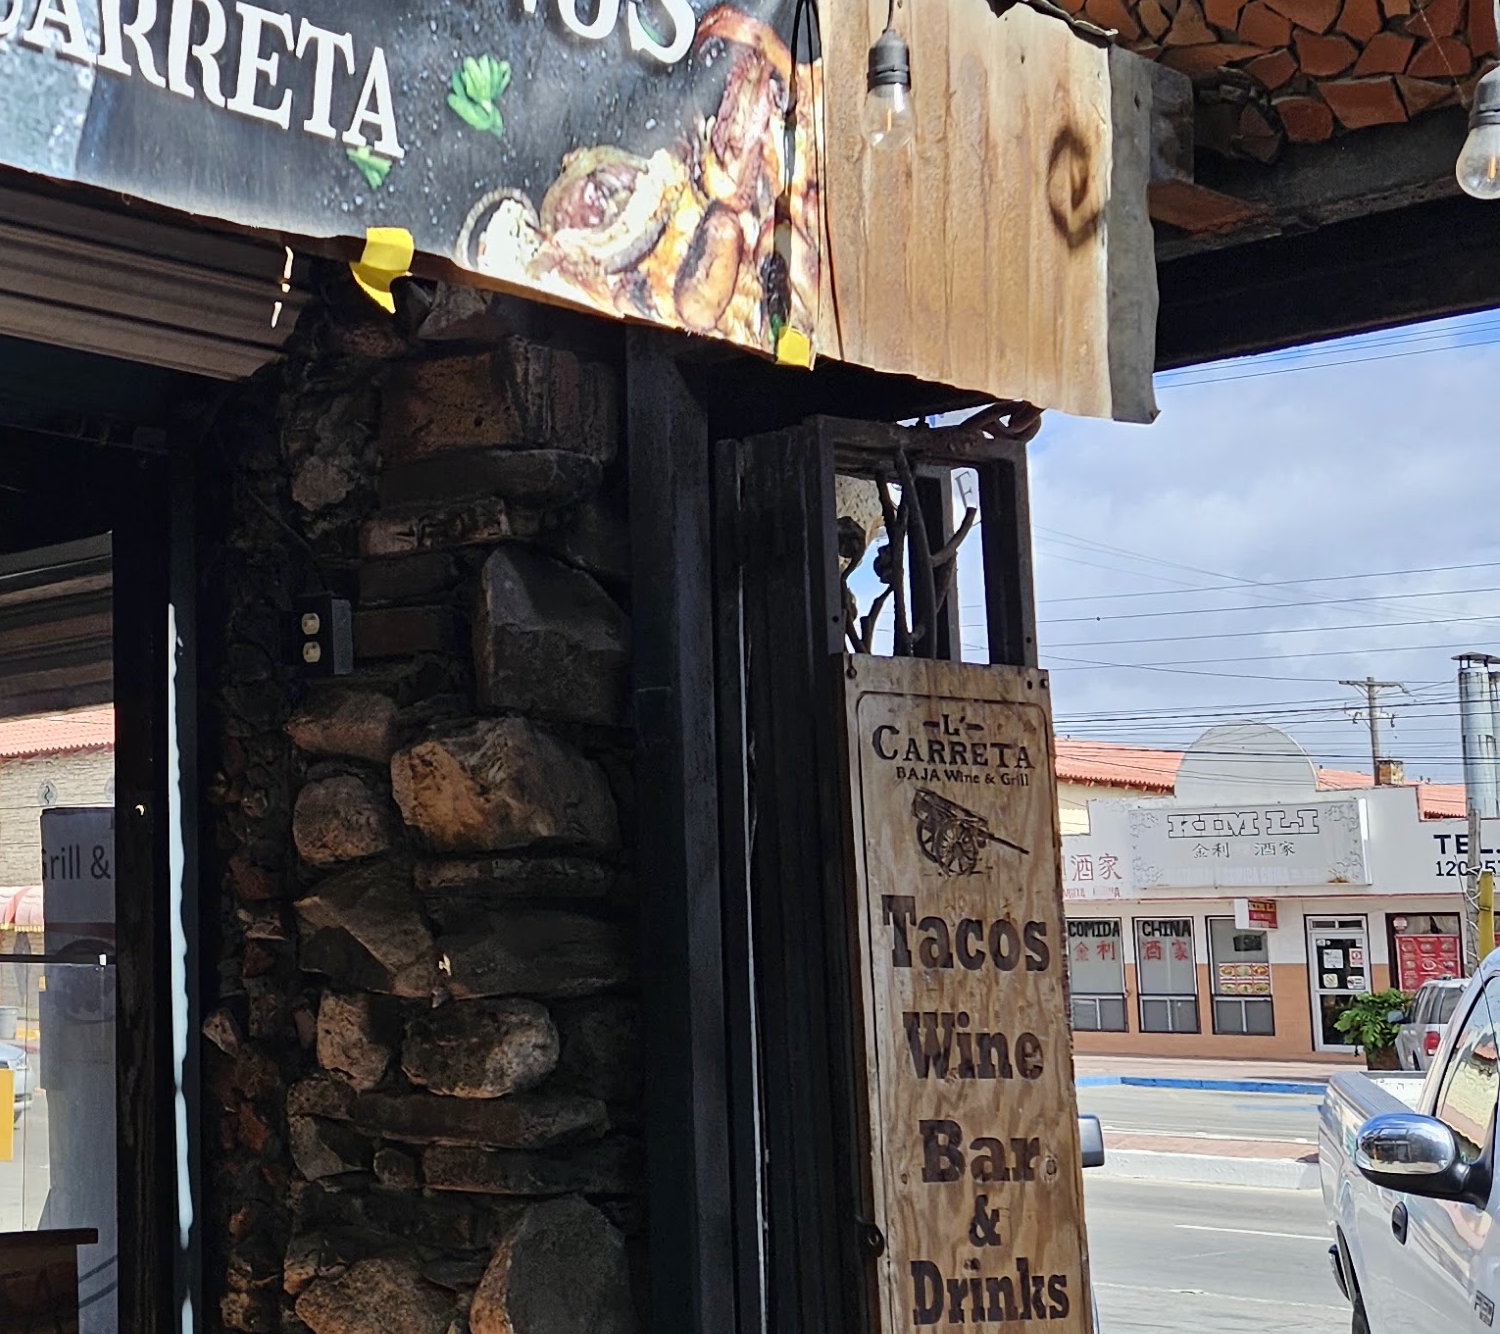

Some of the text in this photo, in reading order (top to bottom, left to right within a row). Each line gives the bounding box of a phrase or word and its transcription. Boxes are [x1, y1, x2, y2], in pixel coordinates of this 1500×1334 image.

[871, 724, 1037, 769] CARRETA
[896, 767, 1029, 786] BAJA Wine & Grill
[1167, 809, 1320, 838] KIM LI
[91, 844, 111, 880] &
[1063, 853, 1122, 881] 酒家
[1192, 841, 1296, 858] 金利 酒家
[881, 894, 1050, 972] Tacos
[1068, 920, 1191, 937] COMIDA CHINA
[1074, 939, 1190, 962] 金利 酒家
[902, 1011, 1045, 1081] Wine
[918, 1119, 1041, 1183] Bar
[968, 1194, 1002, 1247] &
[910, 1256, 1070, 1325] Drinks
